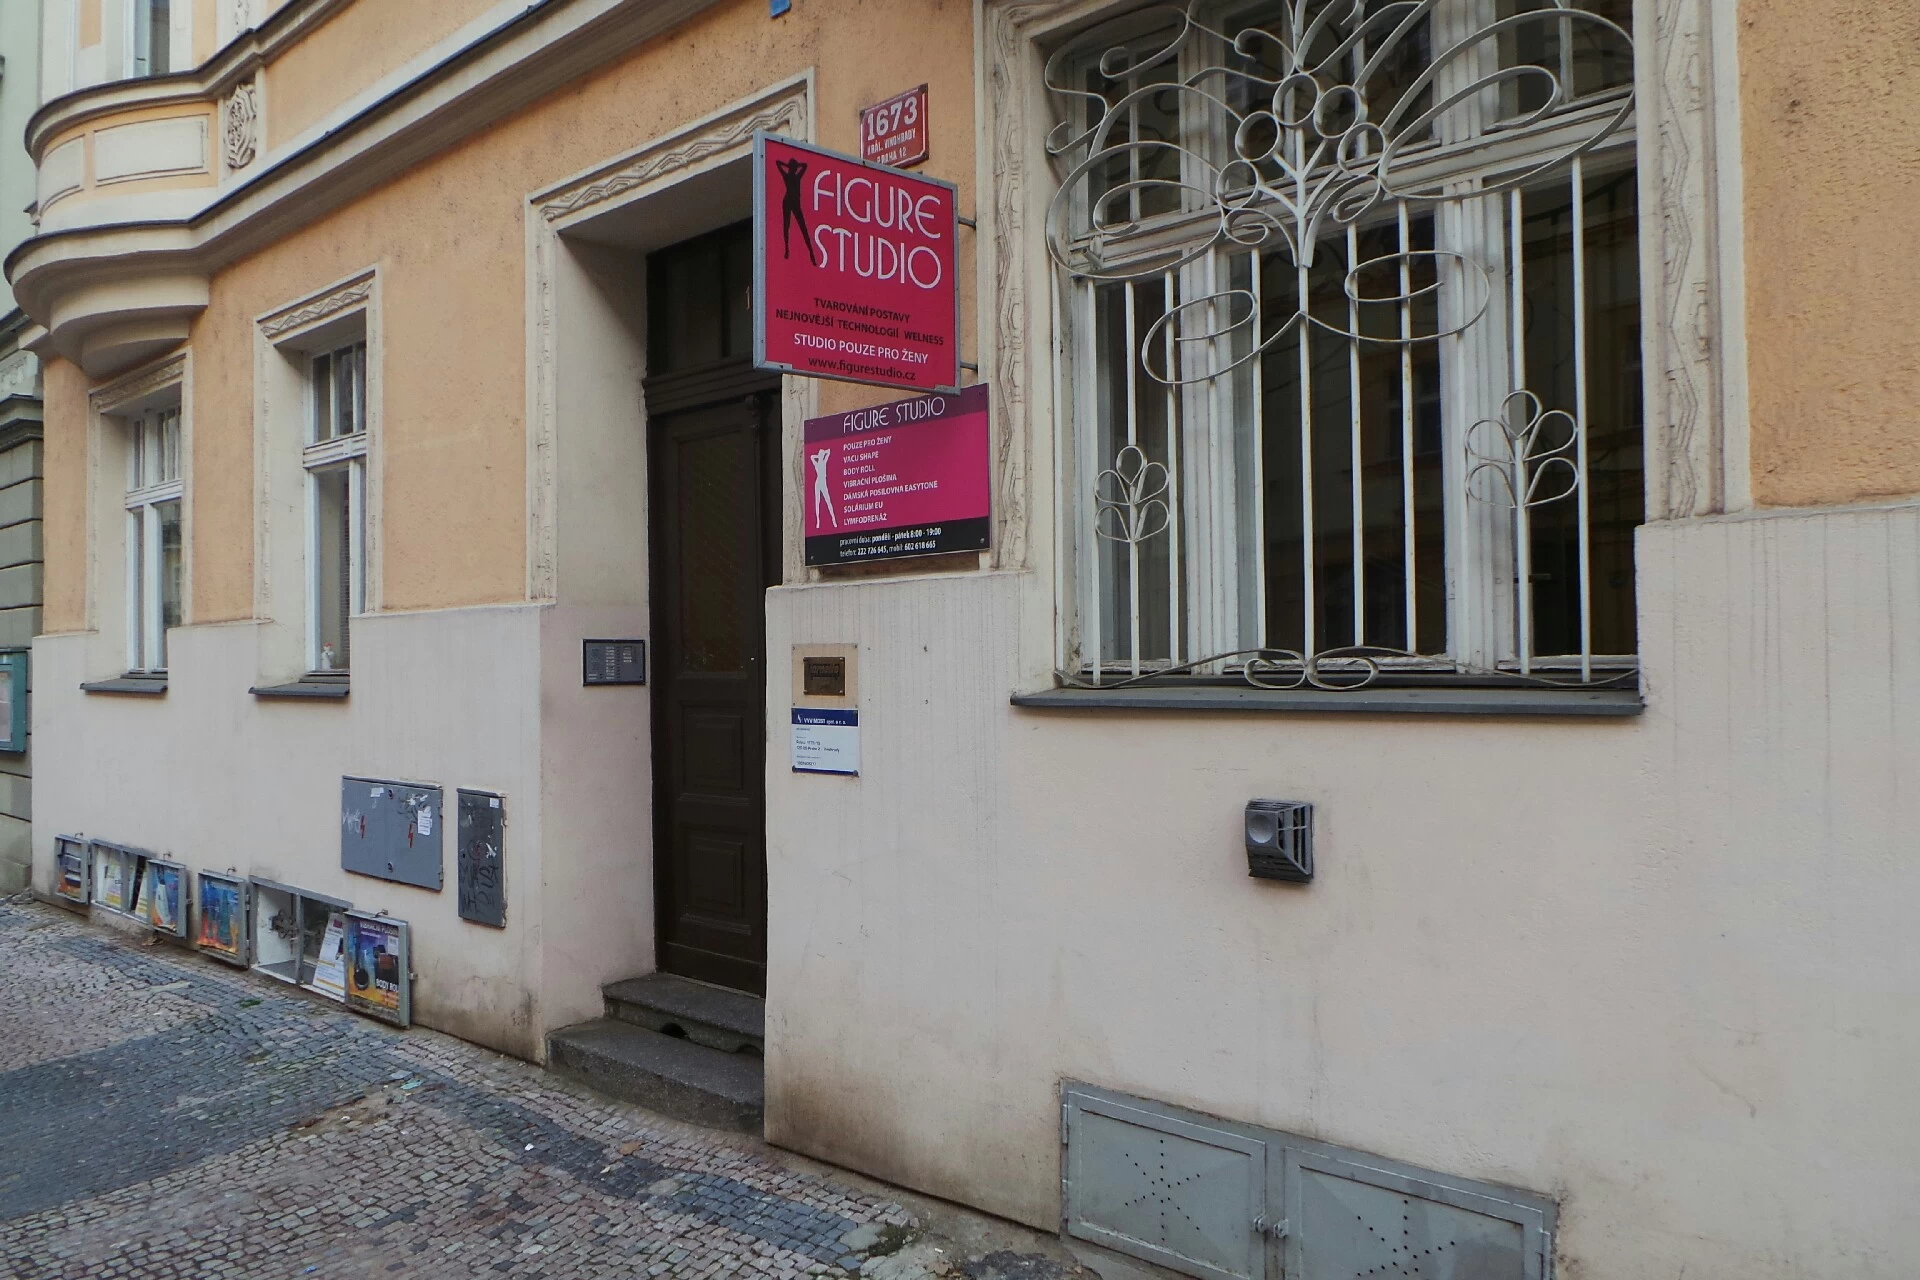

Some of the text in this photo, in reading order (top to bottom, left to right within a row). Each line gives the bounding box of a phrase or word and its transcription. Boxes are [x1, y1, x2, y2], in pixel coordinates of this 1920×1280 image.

[867, 96, 918, 141] 1673
[884, 128, 916, 149] VINOHRADY
[876, 146, 907, 165] PRAHA 12
[813, 169, 941, 239] FIGURE
[814, 224, 942, 289] STUDIO
[814, 298, 911, 323] TVAROVÁNÍ POSTAVY
[776, 308, 944, 346] NEJNOVĚJŠÍ TECHNOLOGIÍ WELNESS
[794, 333, 928, 364] STUDIO POUZE PRO ŽENY
[808, 357, 916, 381] www.figurestudio.cz
[843, 396, 946, 434] FIGURE STUDIO
[843, 435, 892, 451] POUZE PRO ŽENY
[843, 451, 879, 463] VACU SHAPE
[843, 464, 876, 476] BODY ROLL
[843, 473, 897, 488] VIBRAČNÍ PLOŠINA
[843, 480, 938, 501] DÁMSKÁ POSILOVNA EASYTONE
[843, 501, 884, 513] SOLÁRIUM EU
[894, 530, 910, 542] pátek
[857, 547, 867, 556] 222
[904, 542, 914, 551] 602
[914, 541, 926, 550] 618
